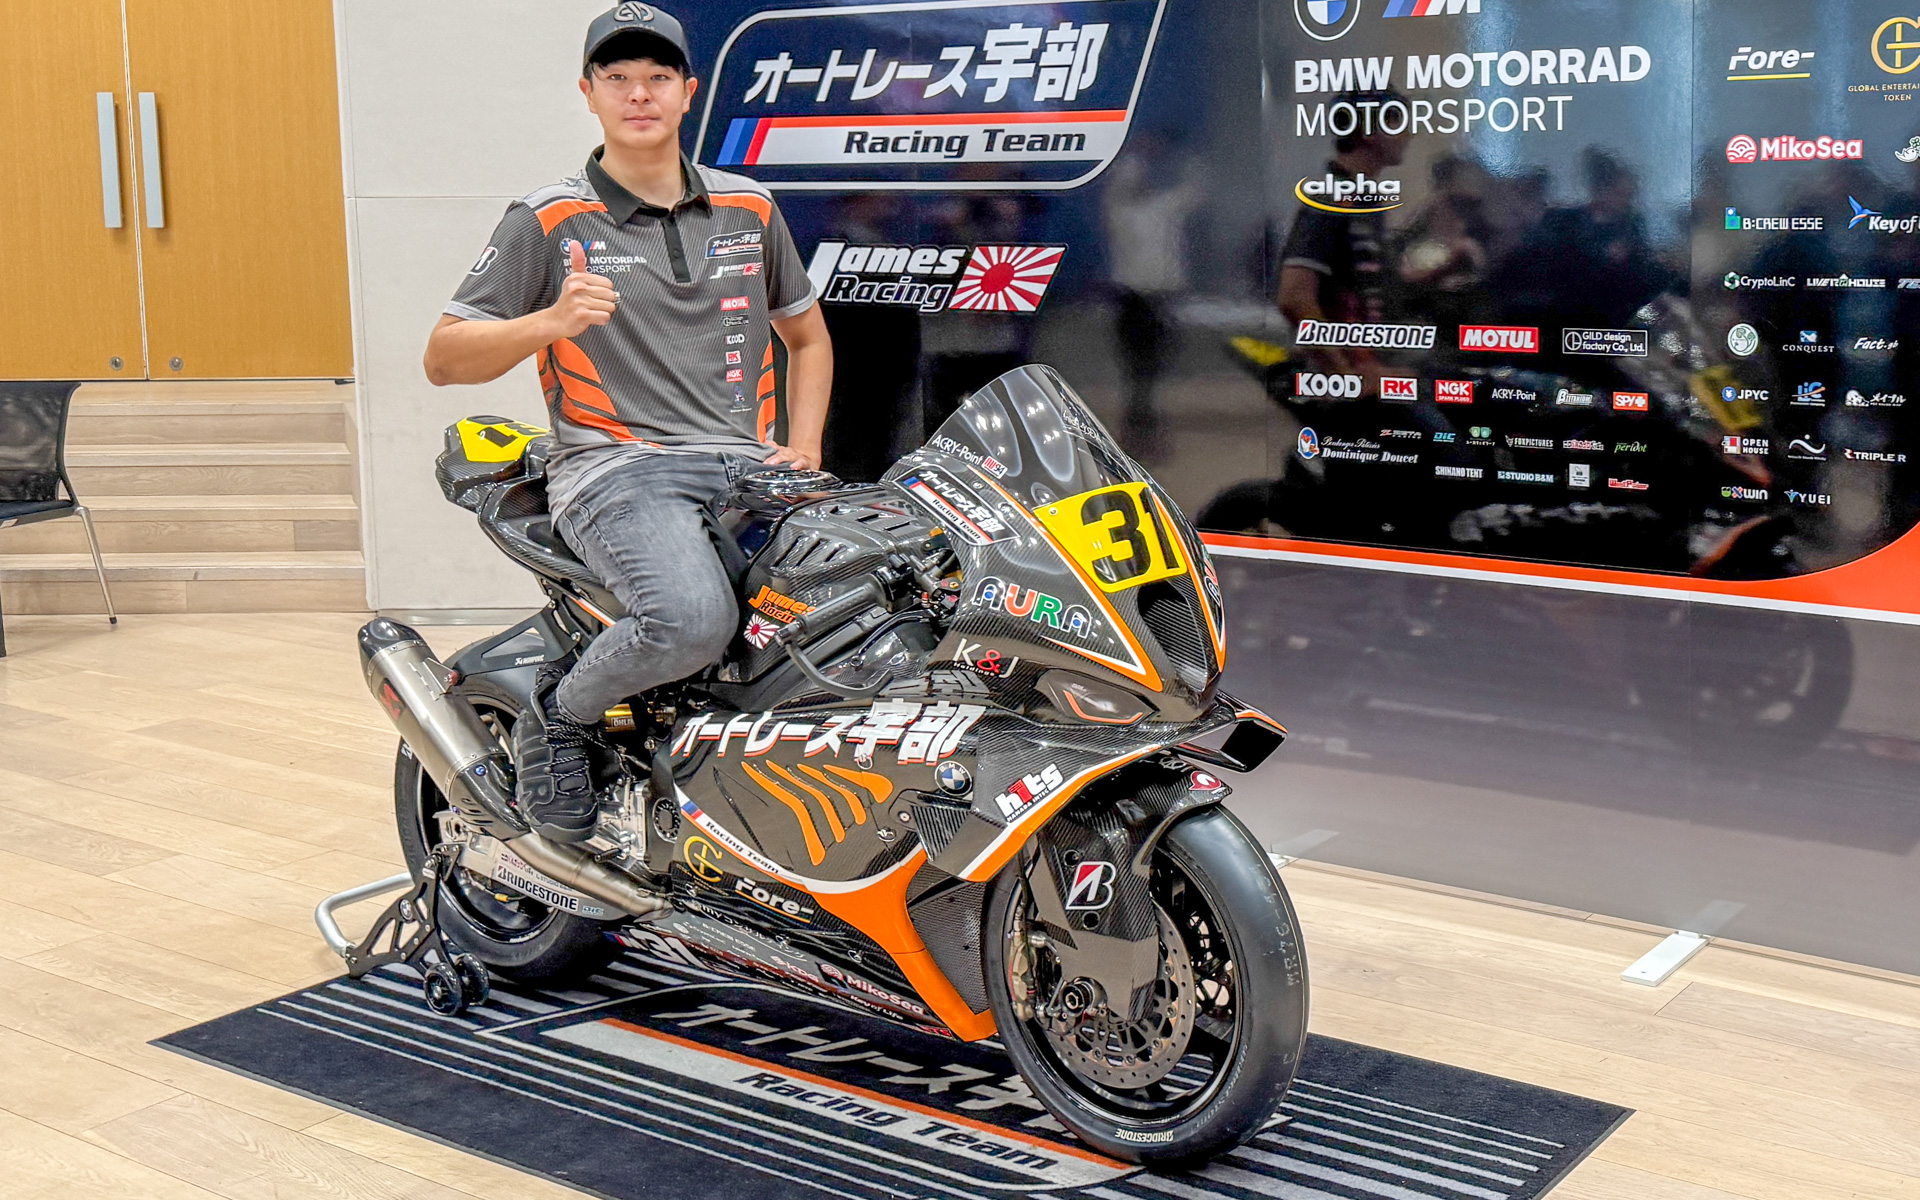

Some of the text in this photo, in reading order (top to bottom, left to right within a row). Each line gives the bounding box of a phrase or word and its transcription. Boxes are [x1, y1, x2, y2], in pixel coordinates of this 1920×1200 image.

[743, 22, 1109, 103] オートレース宇部
[1294, 45, 1651, 93] BMW MOTORRAD
[1848, 84, 1879, 92] GLOBAL
[1295, 95, 1573, 137] MOTORSPORT
[843, 128, 1086, 159] Racing Team
[1760, 136, 1862, 160] MikoSea
[1303, 173, 1400, 201] alpha
[1342, 193, 1400, 202] RACING
[1791, 217, 1823, 230] ESSE
[1868, 215, 1900, 233] Key
[807, 242, 966, 299] James
[1740, 275, 1796, 289] CryptoLinC
[825, 275, 952, 312] Racing
[1297, 320, 1436, 348] BRIDGESTONE
[1463, 329, 1535, 348] MOTUL
[1582, 331, 1631, 342] GILD design
[1582, 343, 1611, 353] factory
[1782, 344, 1834, 353] CONQUEST
[1297, 372, 1362, 398] KOOD
[1383, 379, 1415, 394] RK
[1438, 382, 1470, 396] NGK
[1491, 388, 1536, 401] ACRY-Point
[1737, 390, 1769, 401] JPYC
[931, 434, 984, 466] ACRY-Point
[1742, 438, 1769, 447] OPEN
[1742, 447, 1769, 455] HOUSE
[1321, 447, 1419, 464] Dominique Doucet
[1853, 451, 1907, 462] TRIPLE R
[1505, 471, 1534, 481] STUDIO
[919, 470, 1005, 533] オートレース宇部
[1799, 495, 1831, 505] YUEI
[931, 498, 981, 540] Racing Team
[1080, 486, 1180, 584] 31
[971, 576, 1092, 639] AURA
[952, 637, 1020, 679] K&J
[670, 698, 986, 766] オートレース宇部
[705, 821, 779, 874] Racing Team
[497, 865, 578, 911] BRIDGESTONE
[846, 974, 925, 1016] MikoSea
[651, 1004, 1081, 1139] オートレース宇
[732, 1072, 1059, 1170] Racing Team
[1114, 1128, 1175, 1143] BRIDGESTONE
